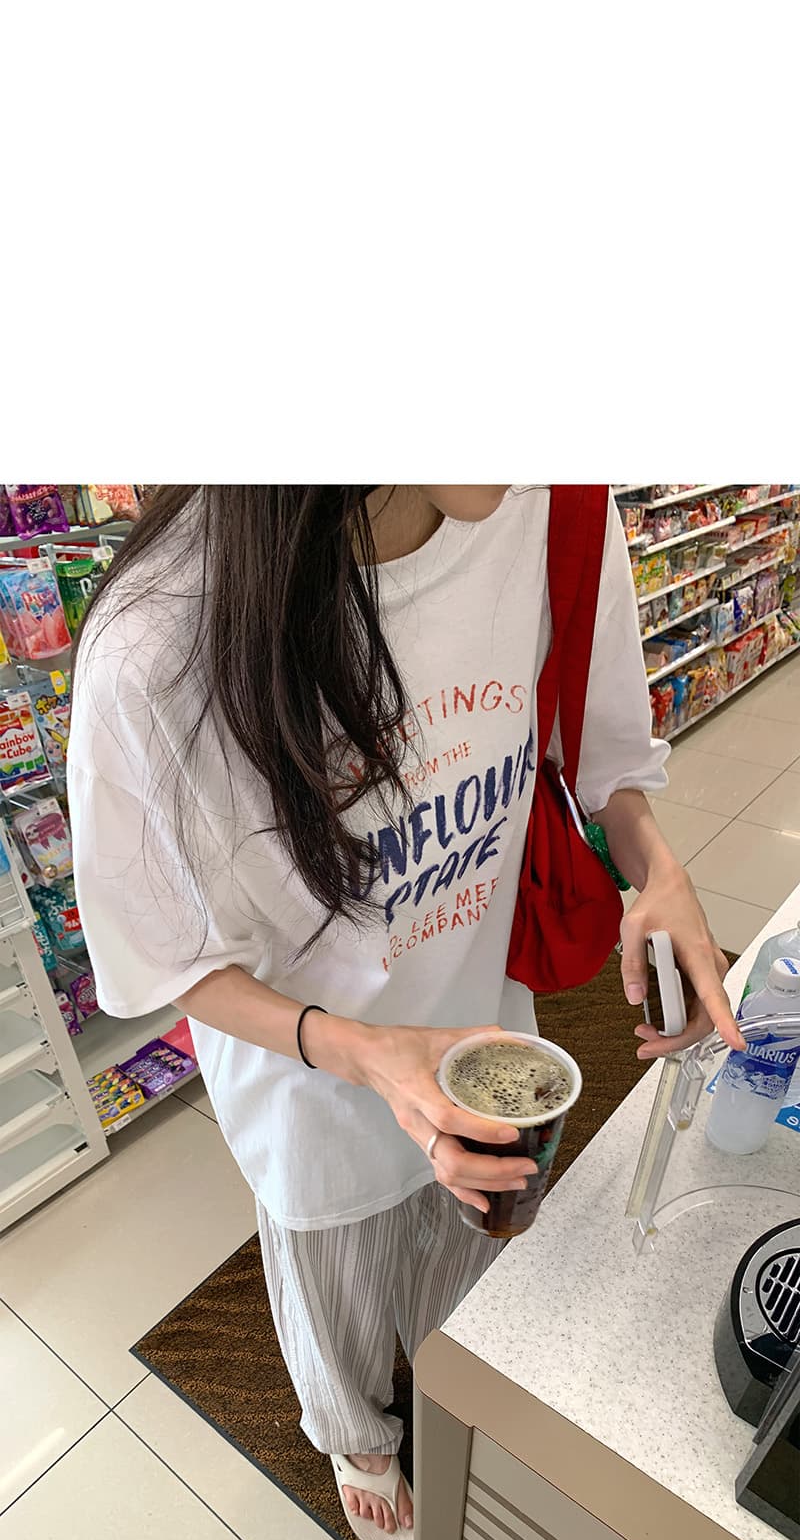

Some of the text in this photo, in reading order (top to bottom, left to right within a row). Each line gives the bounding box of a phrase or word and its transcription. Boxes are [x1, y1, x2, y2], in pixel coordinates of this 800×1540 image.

[0, 733, 35, 750] ainbow
[443, 740, 471, 765] THE
[411, 902, 446, 933] LEE
